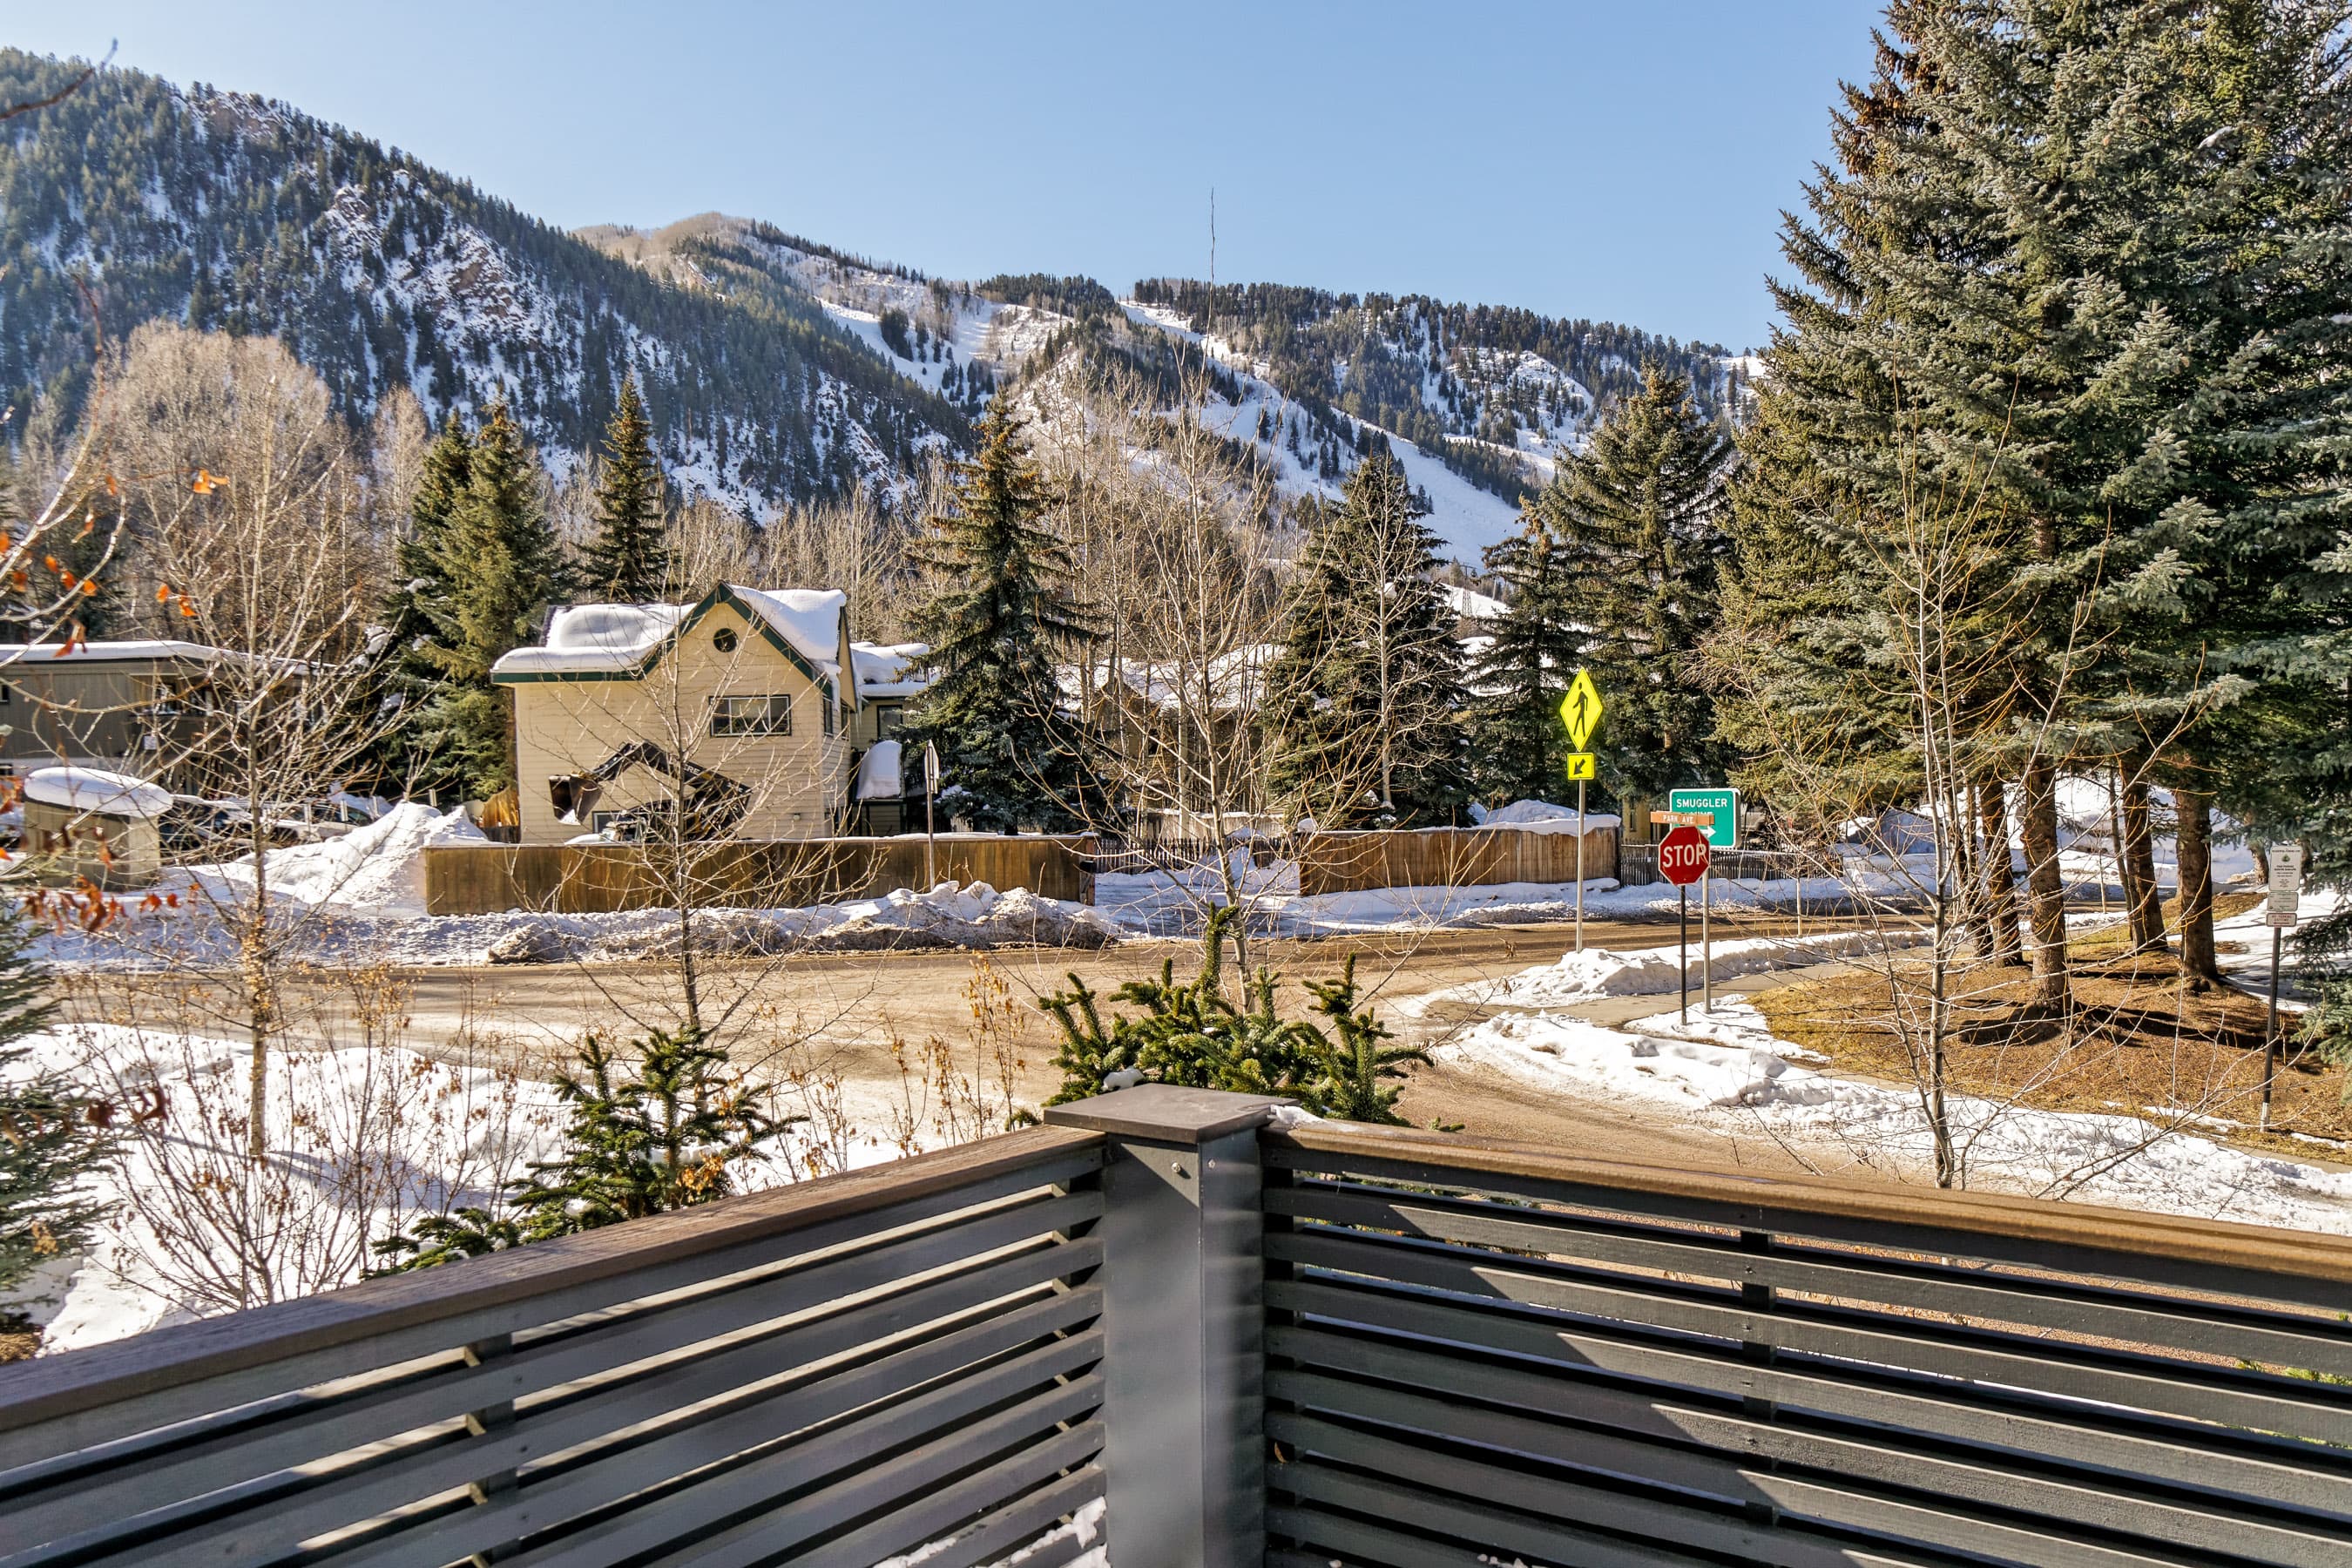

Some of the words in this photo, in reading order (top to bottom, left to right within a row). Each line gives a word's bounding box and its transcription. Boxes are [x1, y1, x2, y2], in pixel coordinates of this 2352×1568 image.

[1676, 798, 1727, 808] SMUGGLER
[1663, 814, 1678, 823] PARK
[1682, 815, 1694, 824] AVE
[1662, 844, 1707, 868] STOP
